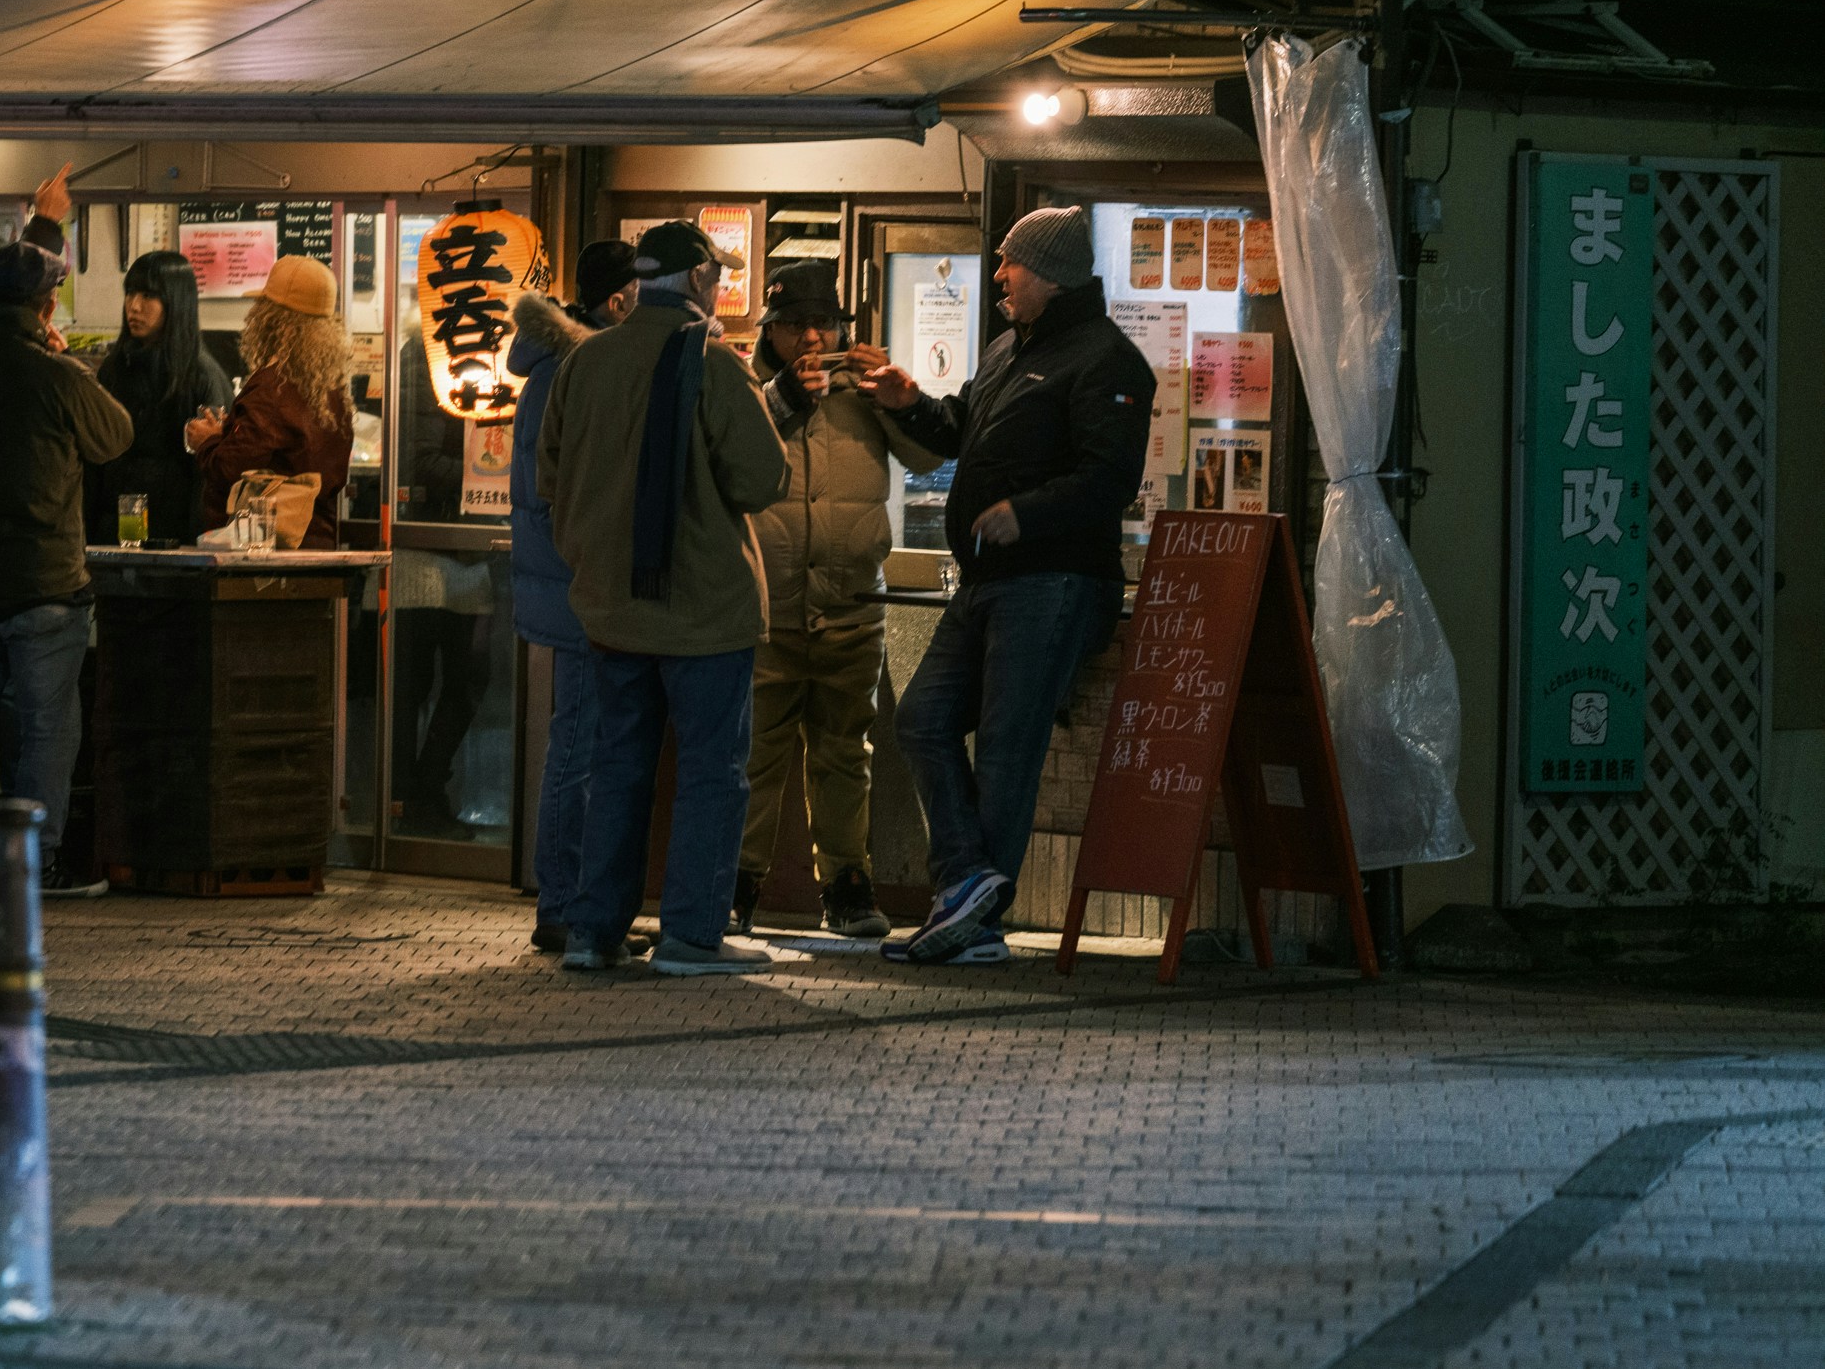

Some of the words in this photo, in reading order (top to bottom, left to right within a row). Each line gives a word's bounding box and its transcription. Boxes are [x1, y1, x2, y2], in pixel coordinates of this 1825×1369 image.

[1560, 187, 1626, 645] ました政次
[1146, 571, 1204, 606] 生ビール
